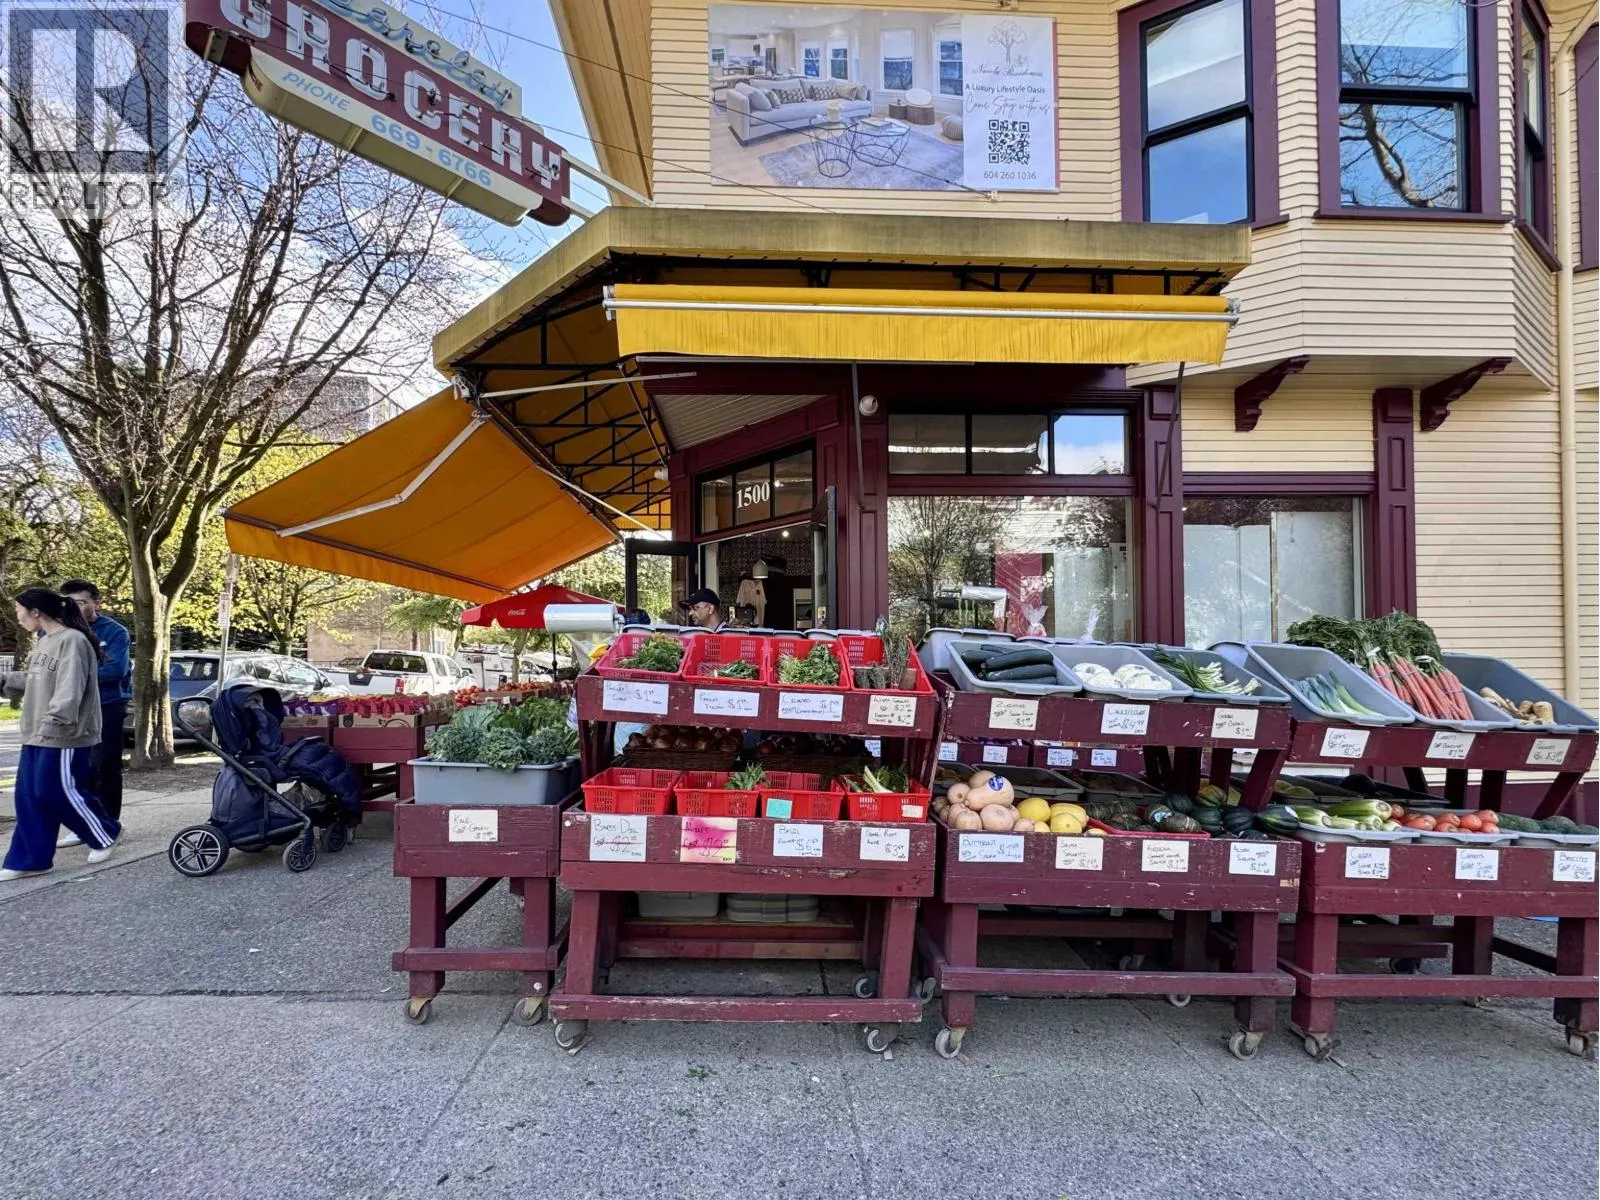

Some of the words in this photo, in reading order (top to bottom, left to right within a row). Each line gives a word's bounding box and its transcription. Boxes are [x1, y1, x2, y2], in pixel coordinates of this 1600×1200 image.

[219, 0, 562, 190] GROCERY
[281, 70, 351, 112] PHONE
[964, 83, 971, 91] A
[971, 84, 996, 94] Luxury
[996, 86, 1026, 95] Lifestyle
[1026, 86, 1046, 94] Oasis
[983, 170, 999, 180] 604
[1000, 171, 1016, 180] 260
[1016, 171, 1037, 180] 1036
[736, 481, 771, 509] 1500
